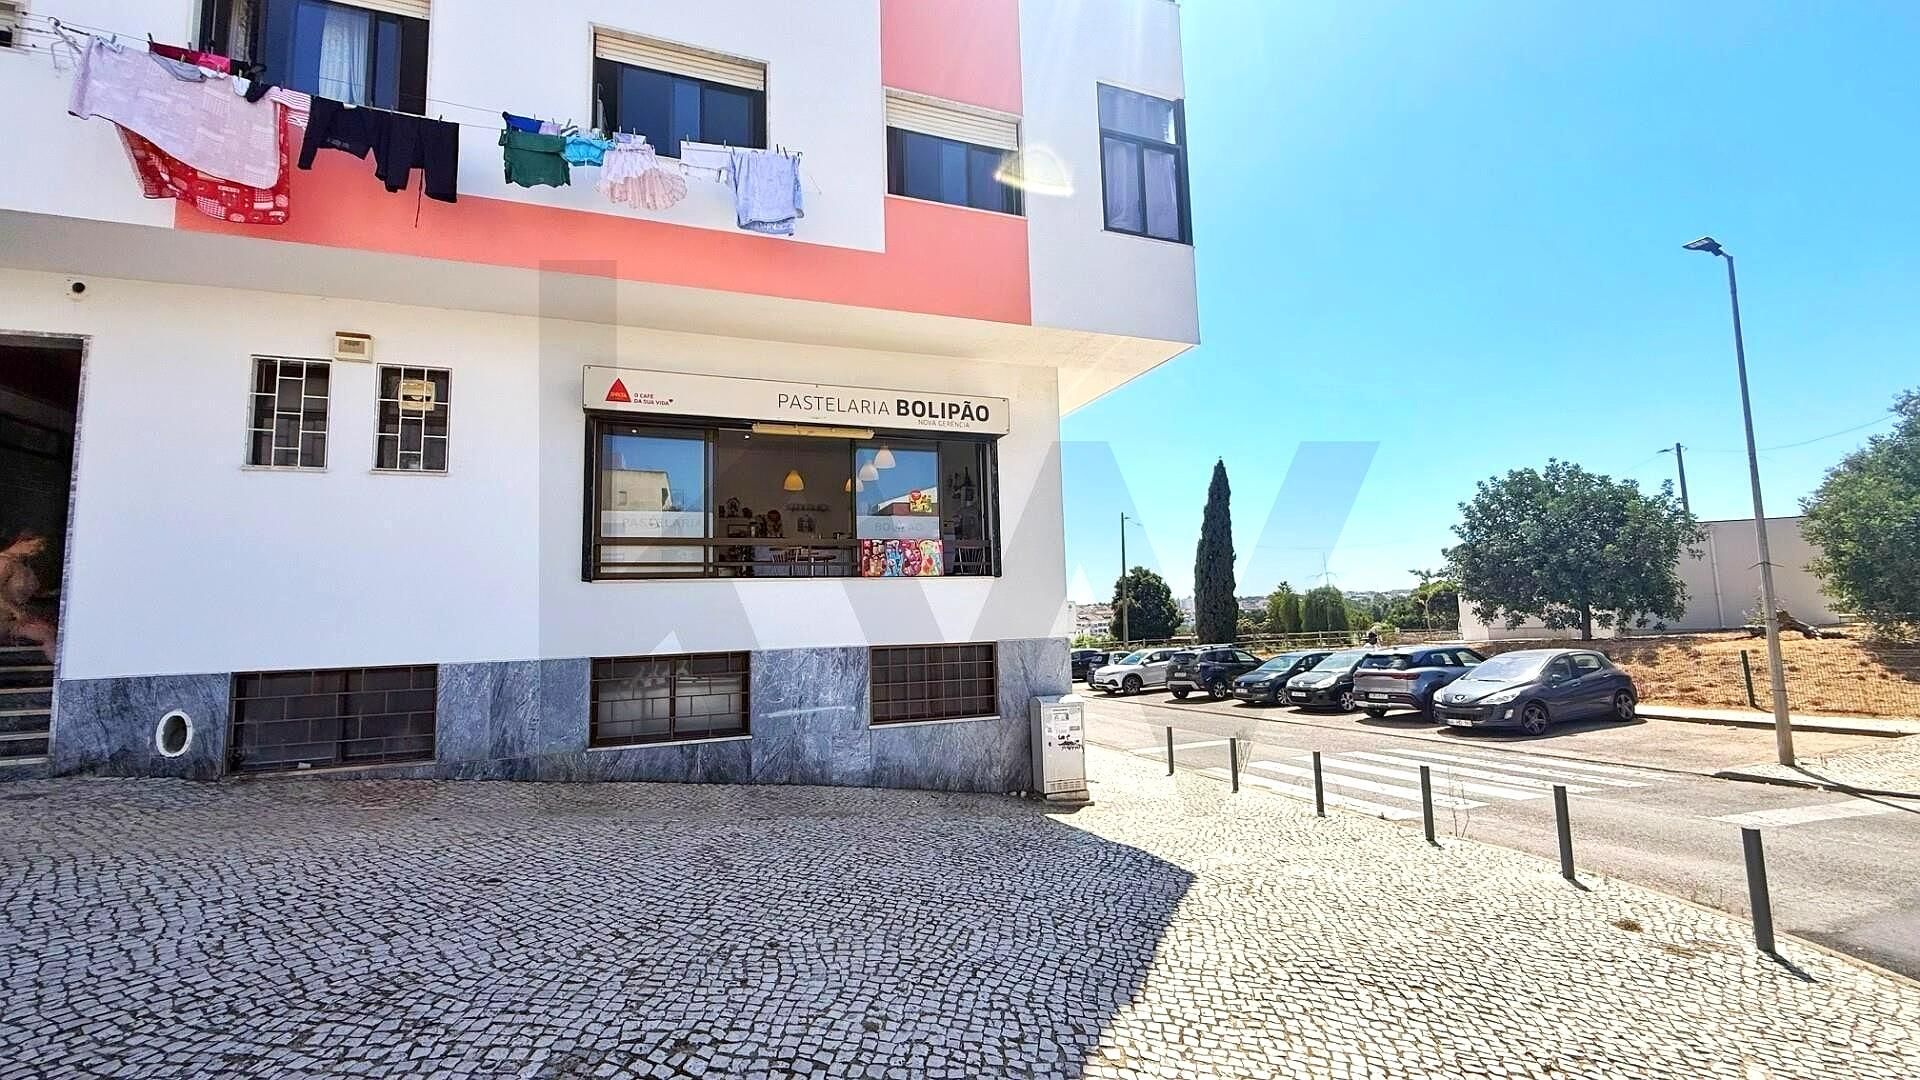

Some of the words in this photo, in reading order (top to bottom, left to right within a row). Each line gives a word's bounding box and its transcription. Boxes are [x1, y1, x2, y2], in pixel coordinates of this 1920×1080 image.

[778, 393, 890, 416] PASTELARIA
[896, 399, 990, 422] BOLIPÃO
[918, 419, 937, 427] NOVA
